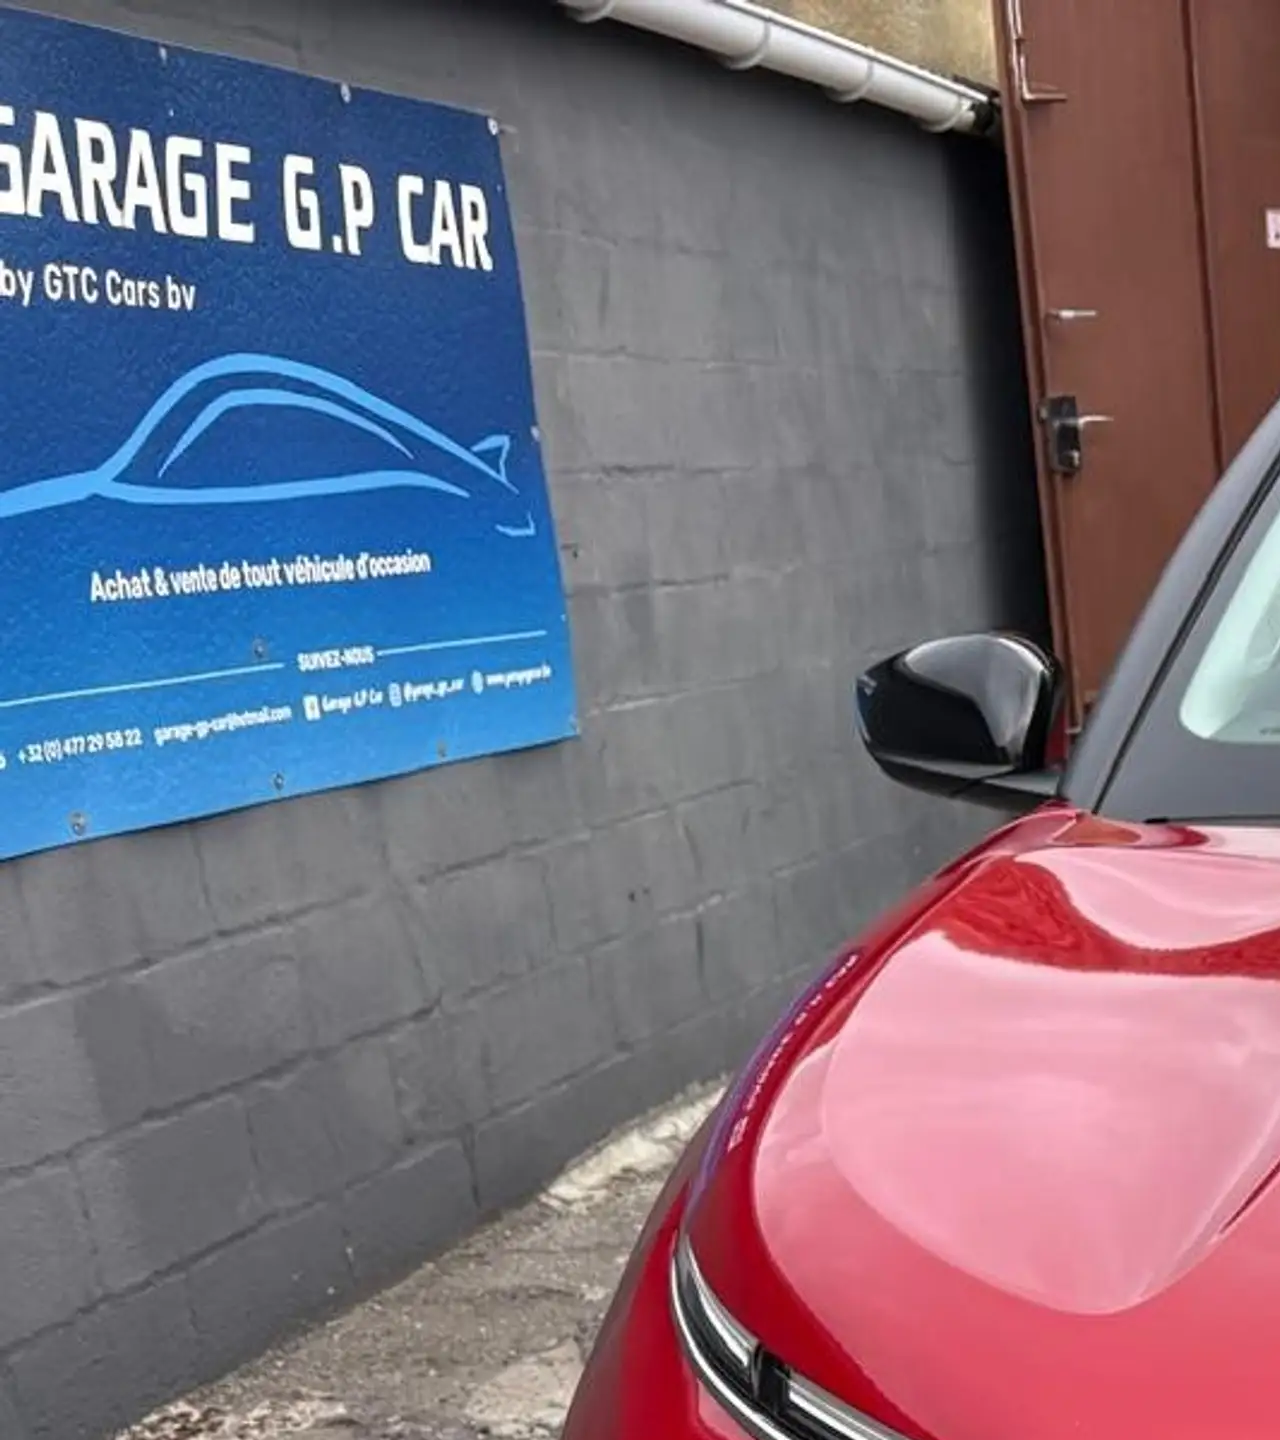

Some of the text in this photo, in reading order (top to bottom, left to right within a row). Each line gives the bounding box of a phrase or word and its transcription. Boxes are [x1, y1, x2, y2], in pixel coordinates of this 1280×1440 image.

[283, 154, 374, 256] G.P
[397, 174, 493, 272] CAR
[0, 259, 196, 311] by GTC Cars bv
[90, 567, 151, 602] Achat
[154, 565, 169, 597] &
[170, 563, 217, 594] vente
[219, 562, 240, 590] de
[243, 559, 282, 588] tout
[284, 554, 354, 586] véhicule
[298, 645, 374, 672] SUIVEZ-NOUS
